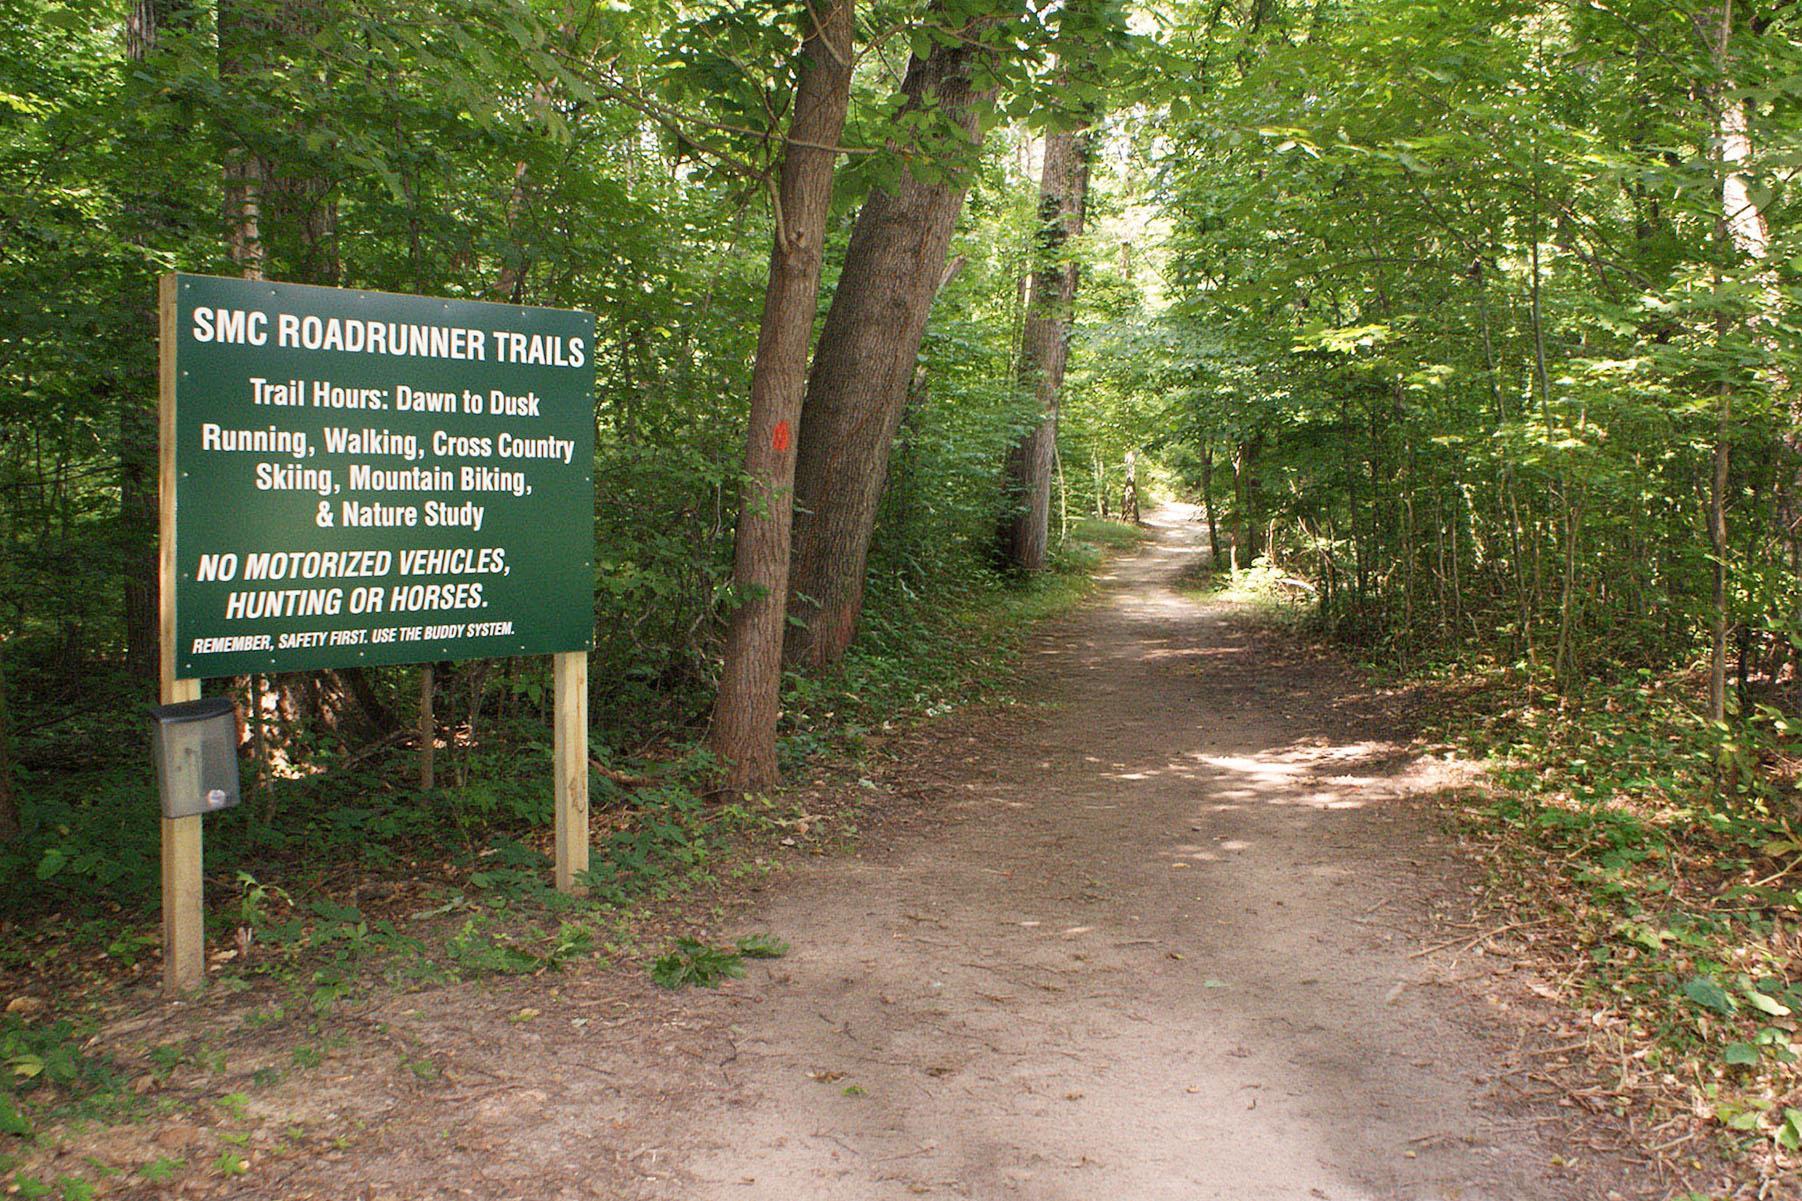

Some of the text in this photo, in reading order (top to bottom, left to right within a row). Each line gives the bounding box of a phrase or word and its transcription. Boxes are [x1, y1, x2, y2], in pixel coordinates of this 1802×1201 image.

[194, 307, 584, 367] SMC ROADRUNNER TRAILS
[250, 378, 539, 416] Trail Hours: Dawn to Dusk
[203, 424, 574, 464] Running, Walking, Cross Country
[257, 463, 531, 496] Skiing, Mountain Biking,
[316, 501, 484, 531] & Nature Study
[198, 548, 510, 581] NO MOTORIZED VEHICLES,
[226, 583, 487, 619] HUNTING OR HORSES.
[193, 622, 514, 653] REMEMBER, SAFETY FIRST. USE THE BUDDY SYSTEM.
